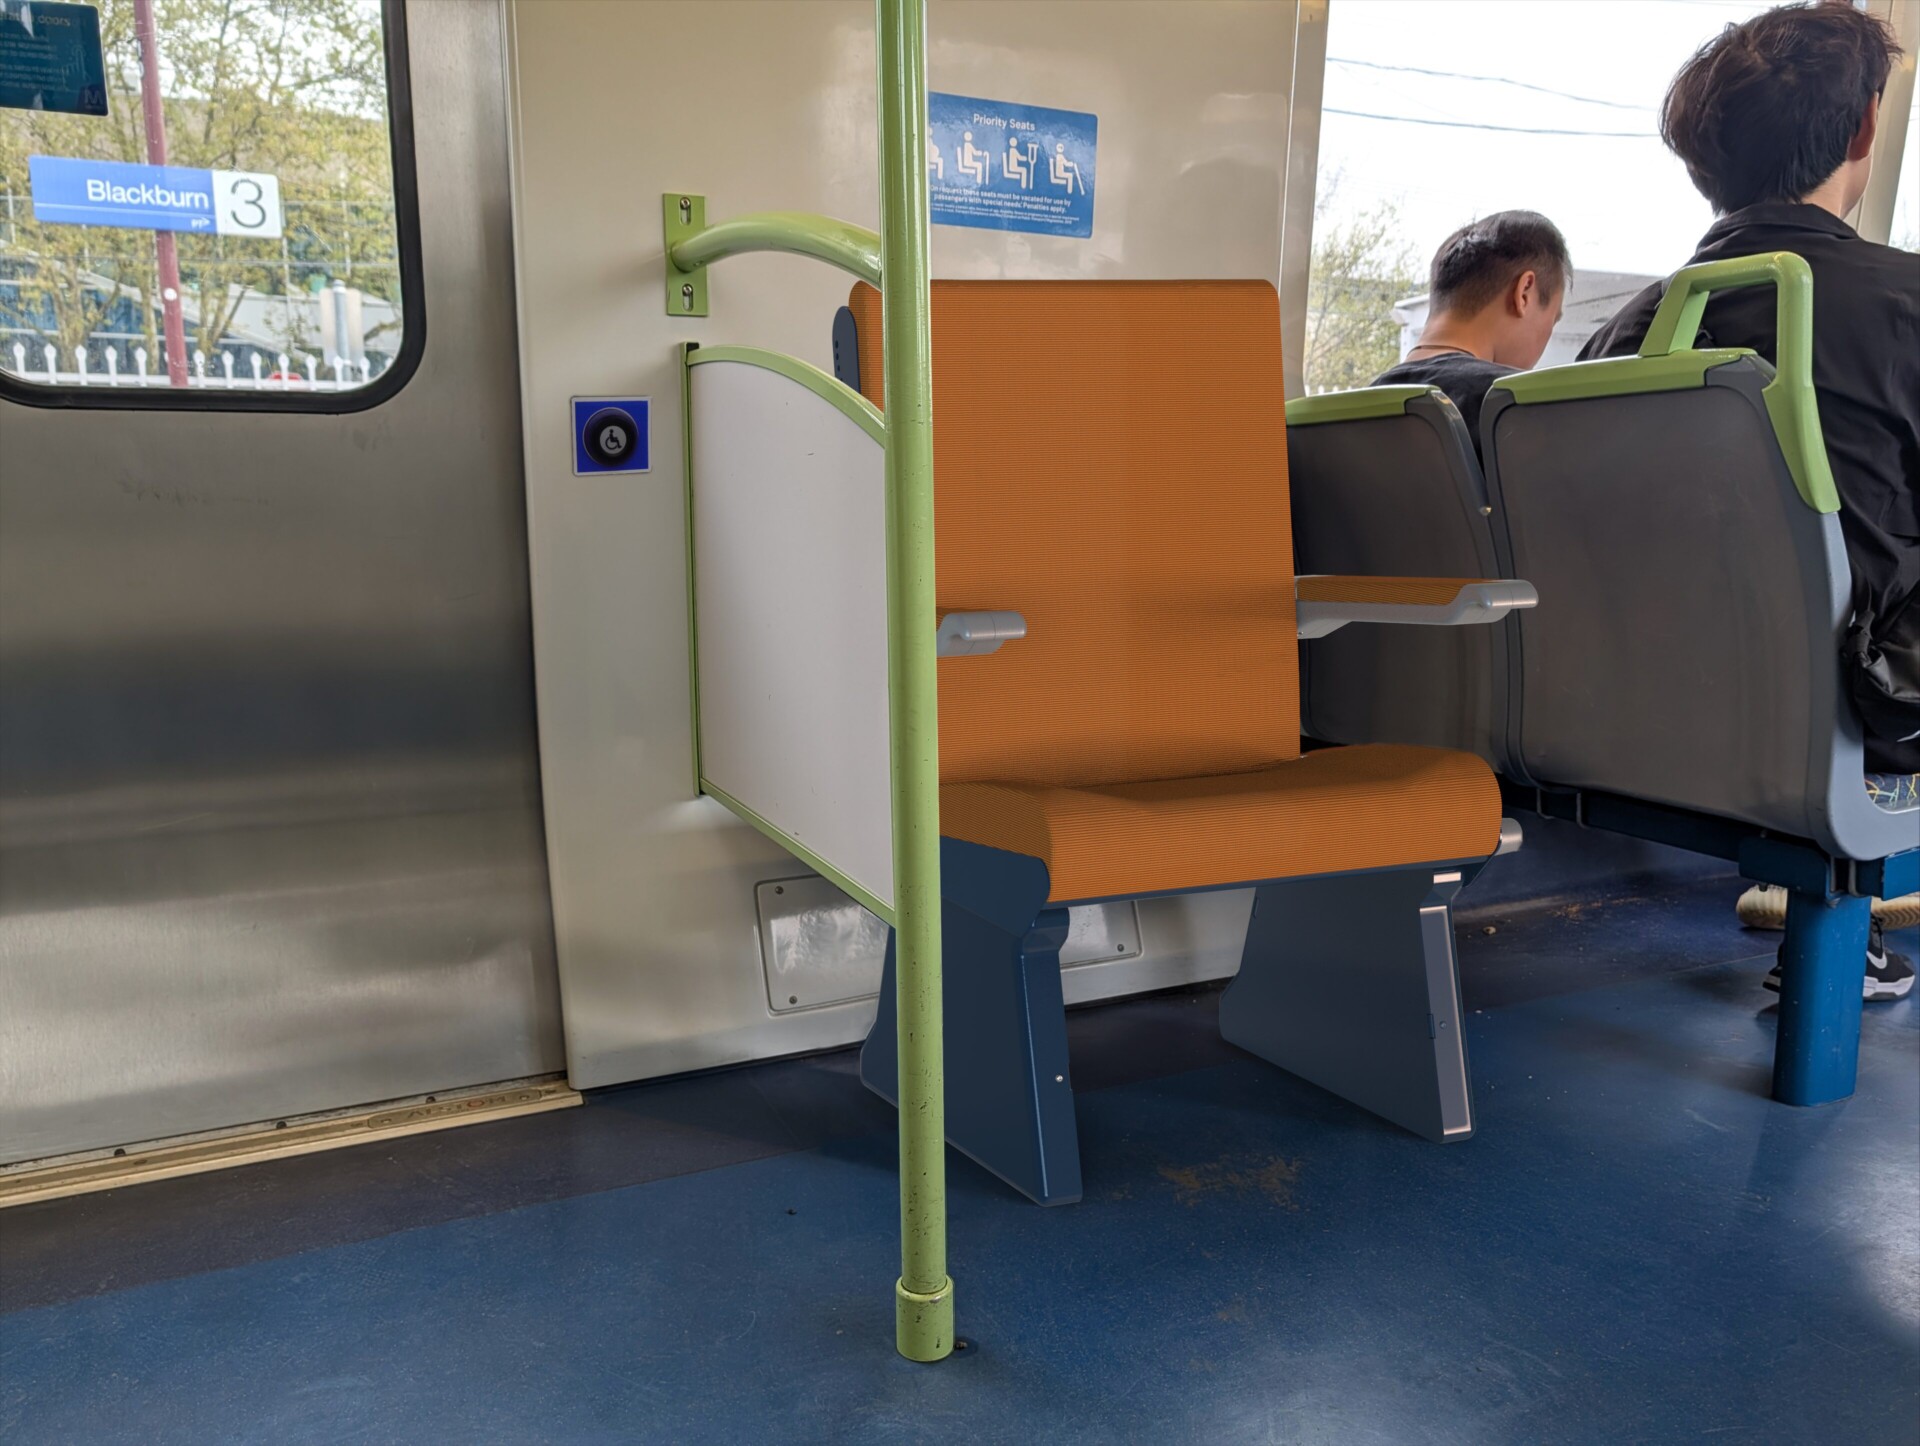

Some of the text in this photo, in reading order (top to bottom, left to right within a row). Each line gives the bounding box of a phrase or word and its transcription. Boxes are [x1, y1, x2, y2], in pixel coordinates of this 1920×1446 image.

[37, 14, 71, 27] doors
[973, 113, 1036, 131] Priority Seats
[86, 179, 209, 210] Blackburn
[230, 178, 267, 229] 3
[934, 194, 967, 203] passengers
[968, 196, 981, 204] with
[982, 198, 1003, 207] special
[1023, 202, 1049, 211] Penalties
[1050, 206, 1066, 214] apply.
[940, 186, 962, 196] request
[963, 188, 979, 197] these
[980, 190, 997, 198] seats
[1021, 195, 1044, 203] vacated
[1064, 198, 1071, 207] by
